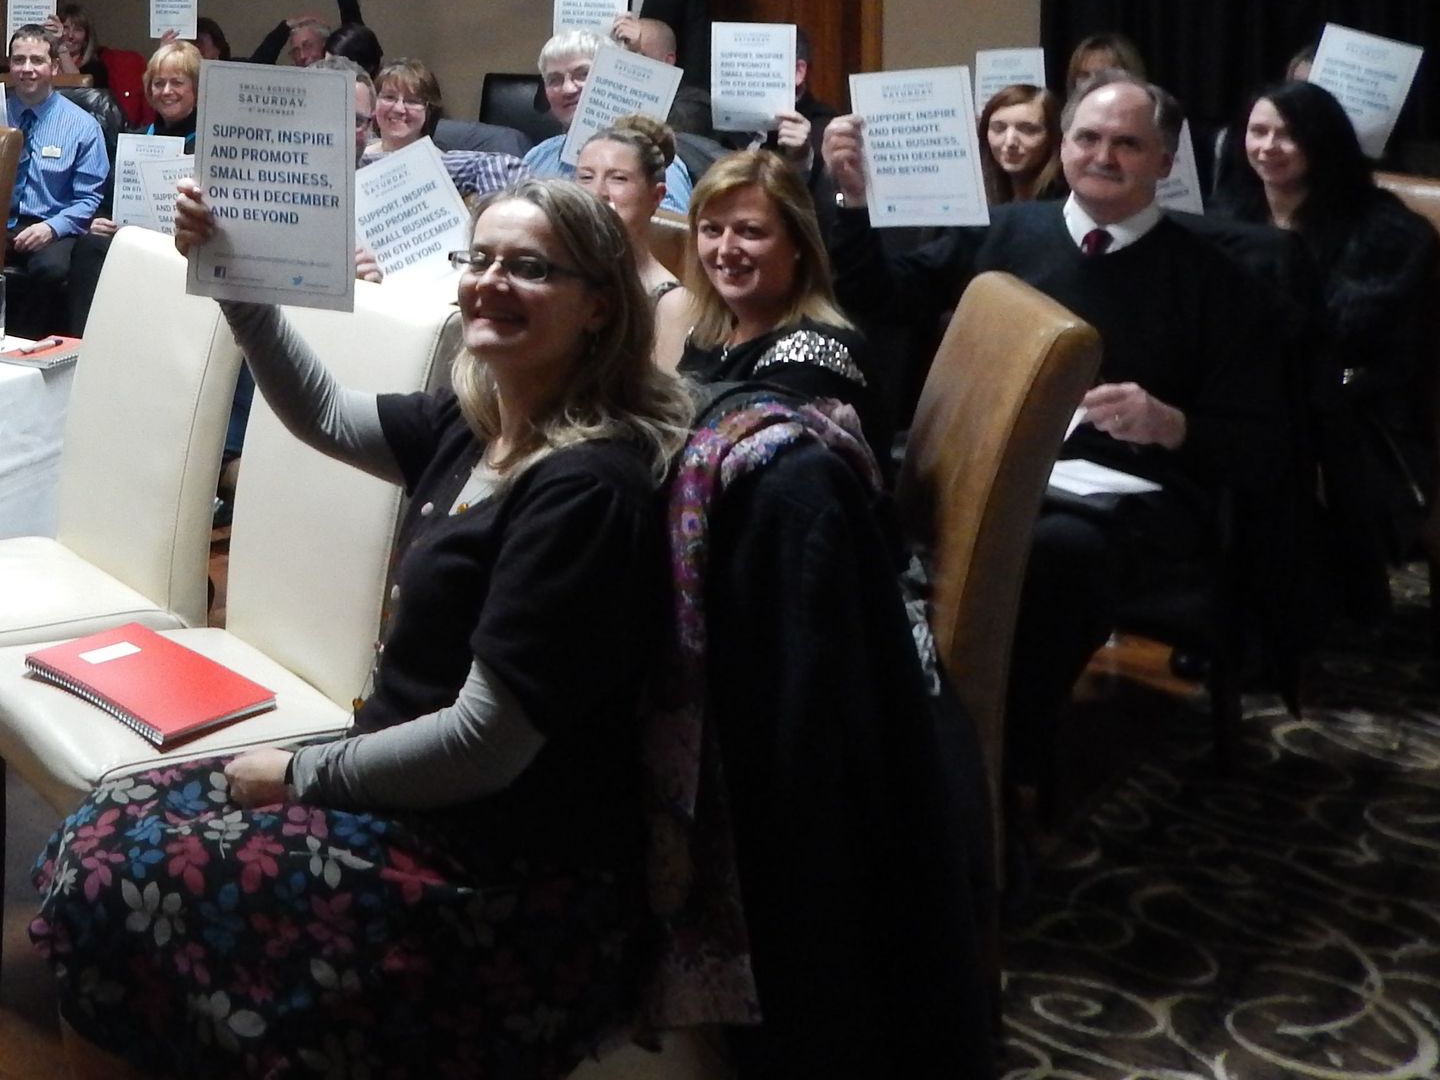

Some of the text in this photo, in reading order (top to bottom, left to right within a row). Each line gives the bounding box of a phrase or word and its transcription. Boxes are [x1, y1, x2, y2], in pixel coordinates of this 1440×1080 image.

[213, 124, 334, 146] SUPPORT, INSPIRE
[211, 145, 309, 165] AND PROMOTE
[210, 166, 333, 188] SMALL BUSINESS,
[209, 186, 339, 208] ON 6TH DECEMBER
[359, 182, 435, 225] SUPPORT, INSPIRE
[211, 207, 299, 224] AND BEYOND
[366, 202, 428, 238] AND PROMOTE
[371, 208, 448, 249] SMALL BUSINESS,
[378, 217, 458, 261] ON 6TH DECEMBER
[385, 242, 441, 274] AND BEYOND
